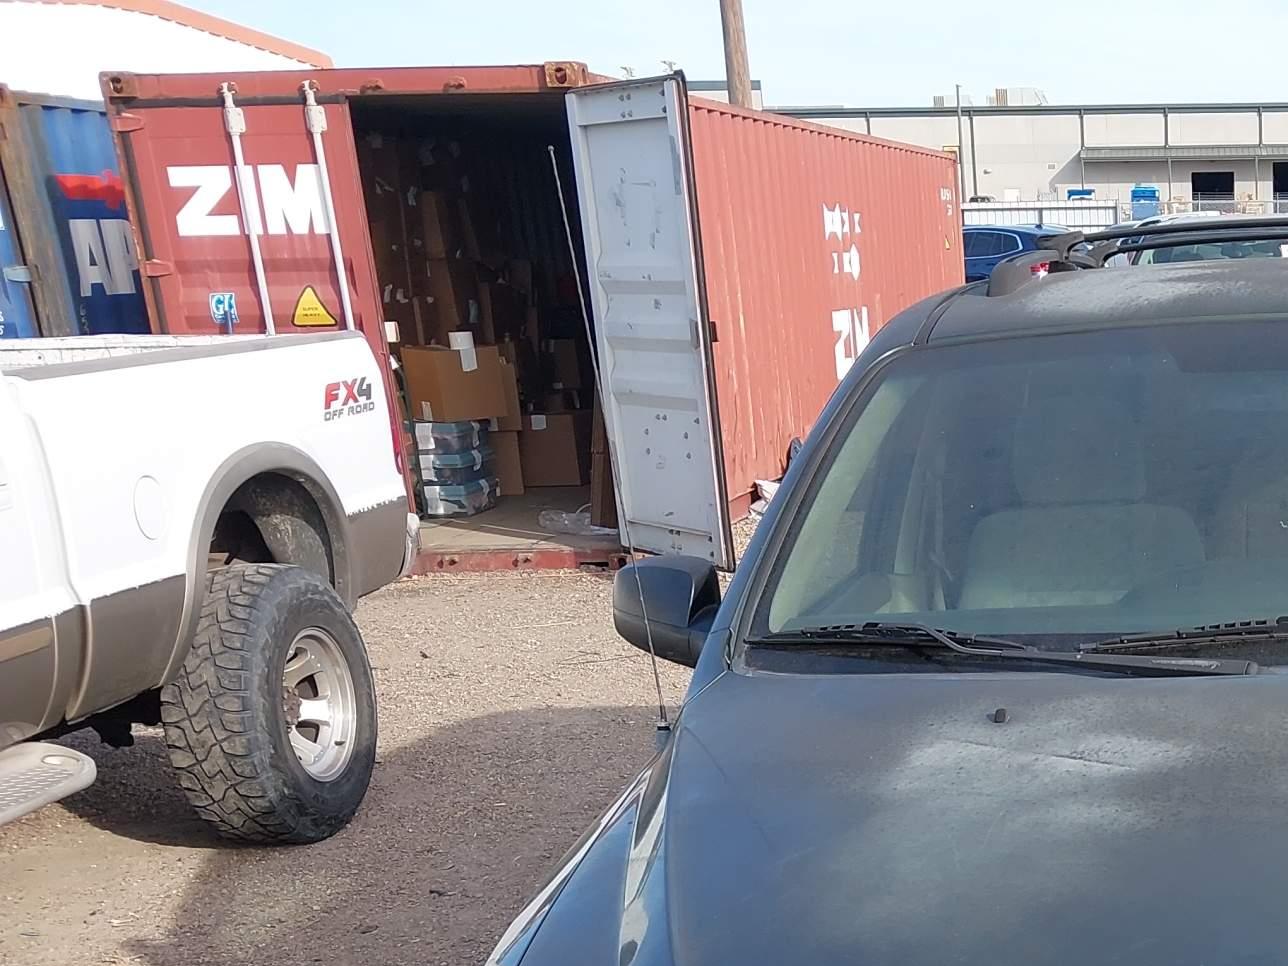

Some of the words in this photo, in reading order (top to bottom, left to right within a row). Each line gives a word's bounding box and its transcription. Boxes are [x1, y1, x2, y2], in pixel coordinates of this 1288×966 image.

[167, 164, 331, 237] ZIM
[324, 376, 372, 410] FX4
[324, 408, 345, 422] OFF
[347, 401, 375, 416] ROAD
